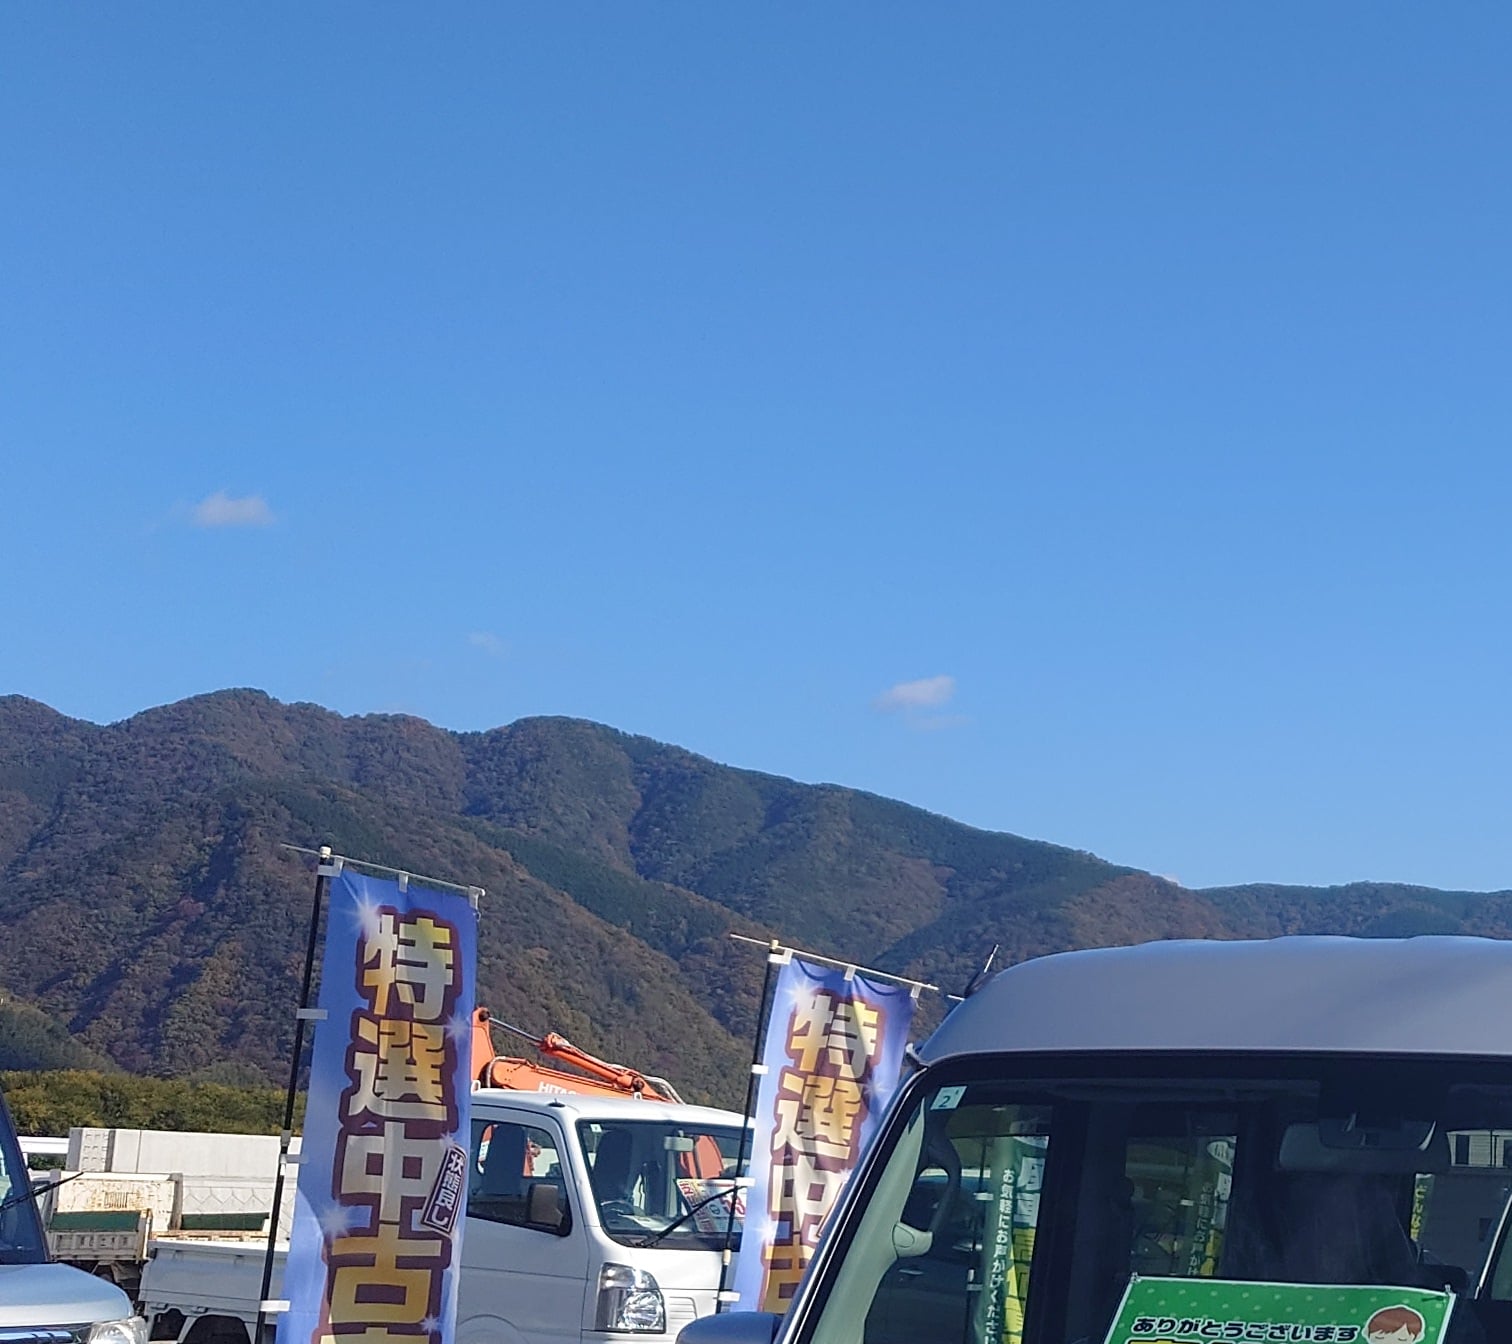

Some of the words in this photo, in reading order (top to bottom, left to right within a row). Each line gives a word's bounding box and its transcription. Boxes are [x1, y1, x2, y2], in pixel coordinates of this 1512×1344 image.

[431, 1153, 465, 1226] 状態良し
[1131, 1316, 1359, 1342] ありがとうございます
